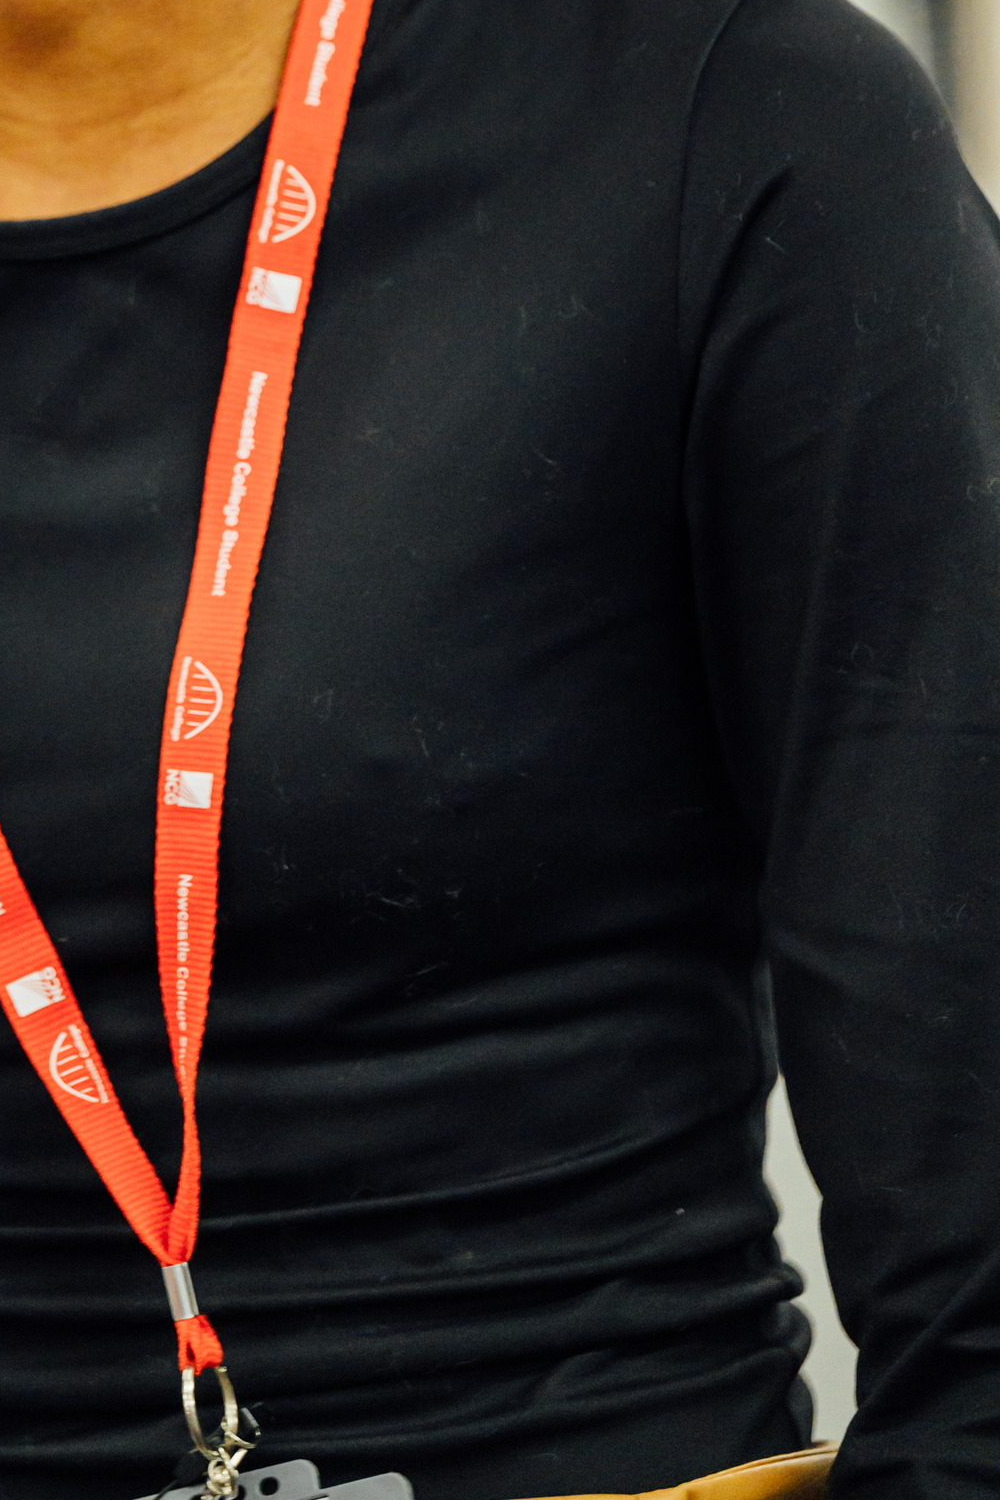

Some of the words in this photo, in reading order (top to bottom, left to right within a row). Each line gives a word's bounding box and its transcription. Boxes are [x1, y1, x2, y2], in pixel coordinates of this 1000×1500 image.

[236, 370, 268, 460] Newcastle
[223, 461, 252, 527] College
[211, 529, 239, 597] Student
[176, 874, 194, 962] Newcastle
[175, 966, 190, 1031] College
